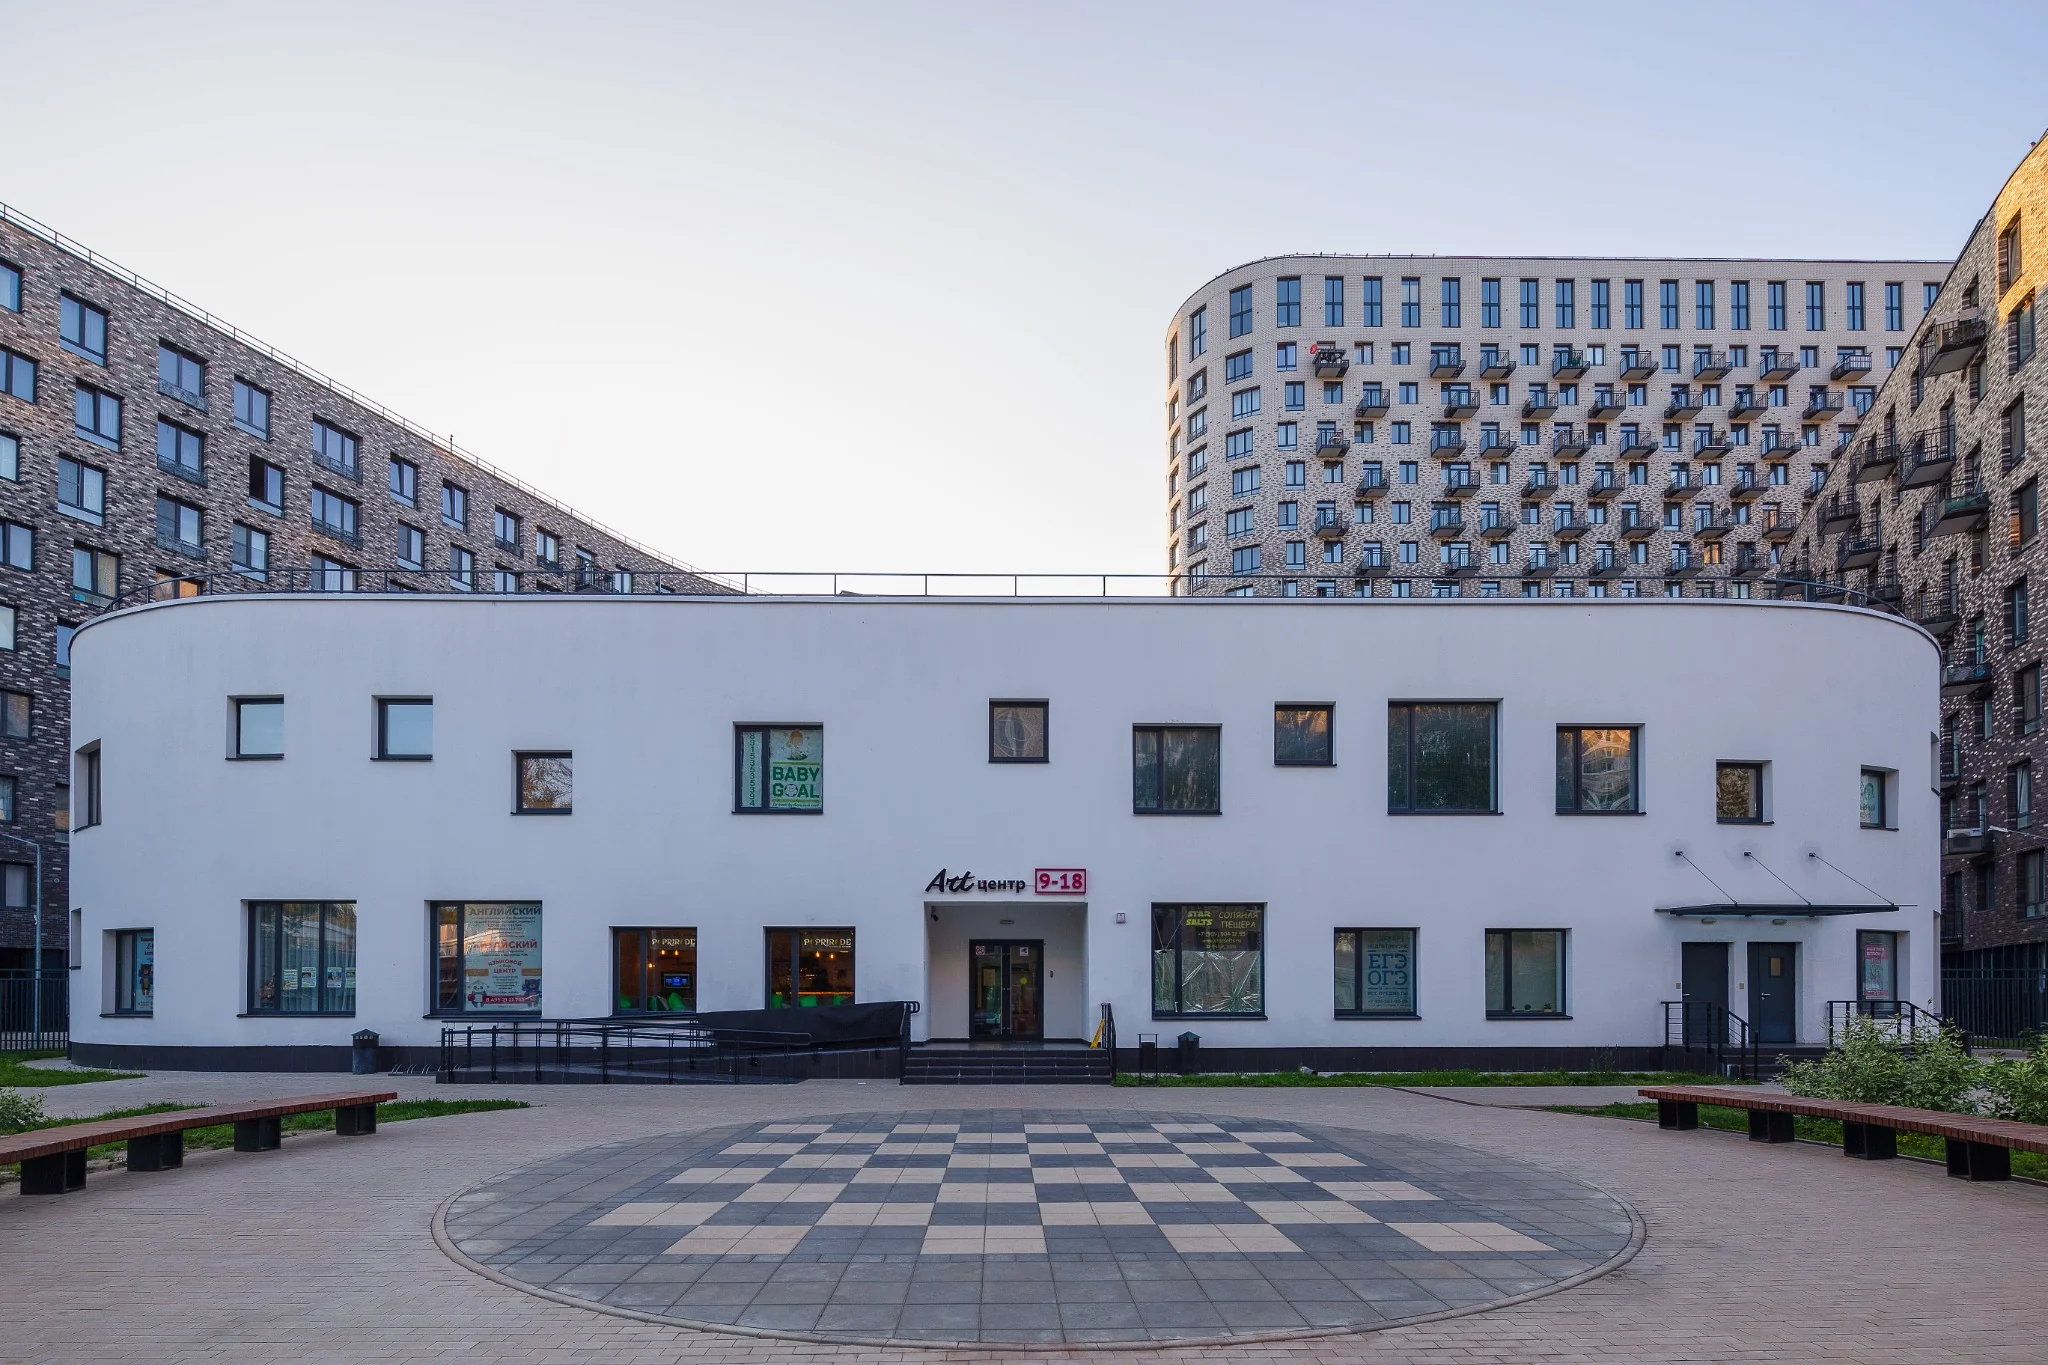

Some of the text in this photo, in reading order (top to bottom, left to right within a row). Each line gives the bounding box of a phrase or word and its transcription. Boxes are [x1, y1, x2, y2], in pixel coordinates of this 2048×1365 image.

[772, 766, 820, 782] BABY
[772, 782, 820, 798] GOAL
[925, 868, 975, 893] Art
[977, 879, 1026, 893] центр
[1038, 872, 1083, 890] 9-18
[469, 906, 541, 916] АНГЛИЙСКИЙ
[1187, 910, 1212, 918] STAR
[1218, 911, 1259, 919] СОЛЯНАЯ
[1185, 918, 1213, 926] SALTS
[1220, 920, 1256, 929] ПЕЩЕРА
[473, 939, 538, 949] АЙСКИЙ
[1368, 953, 1408, 969] ЕГЭ
[1367, 970, 1408, 986] ОГЭ
